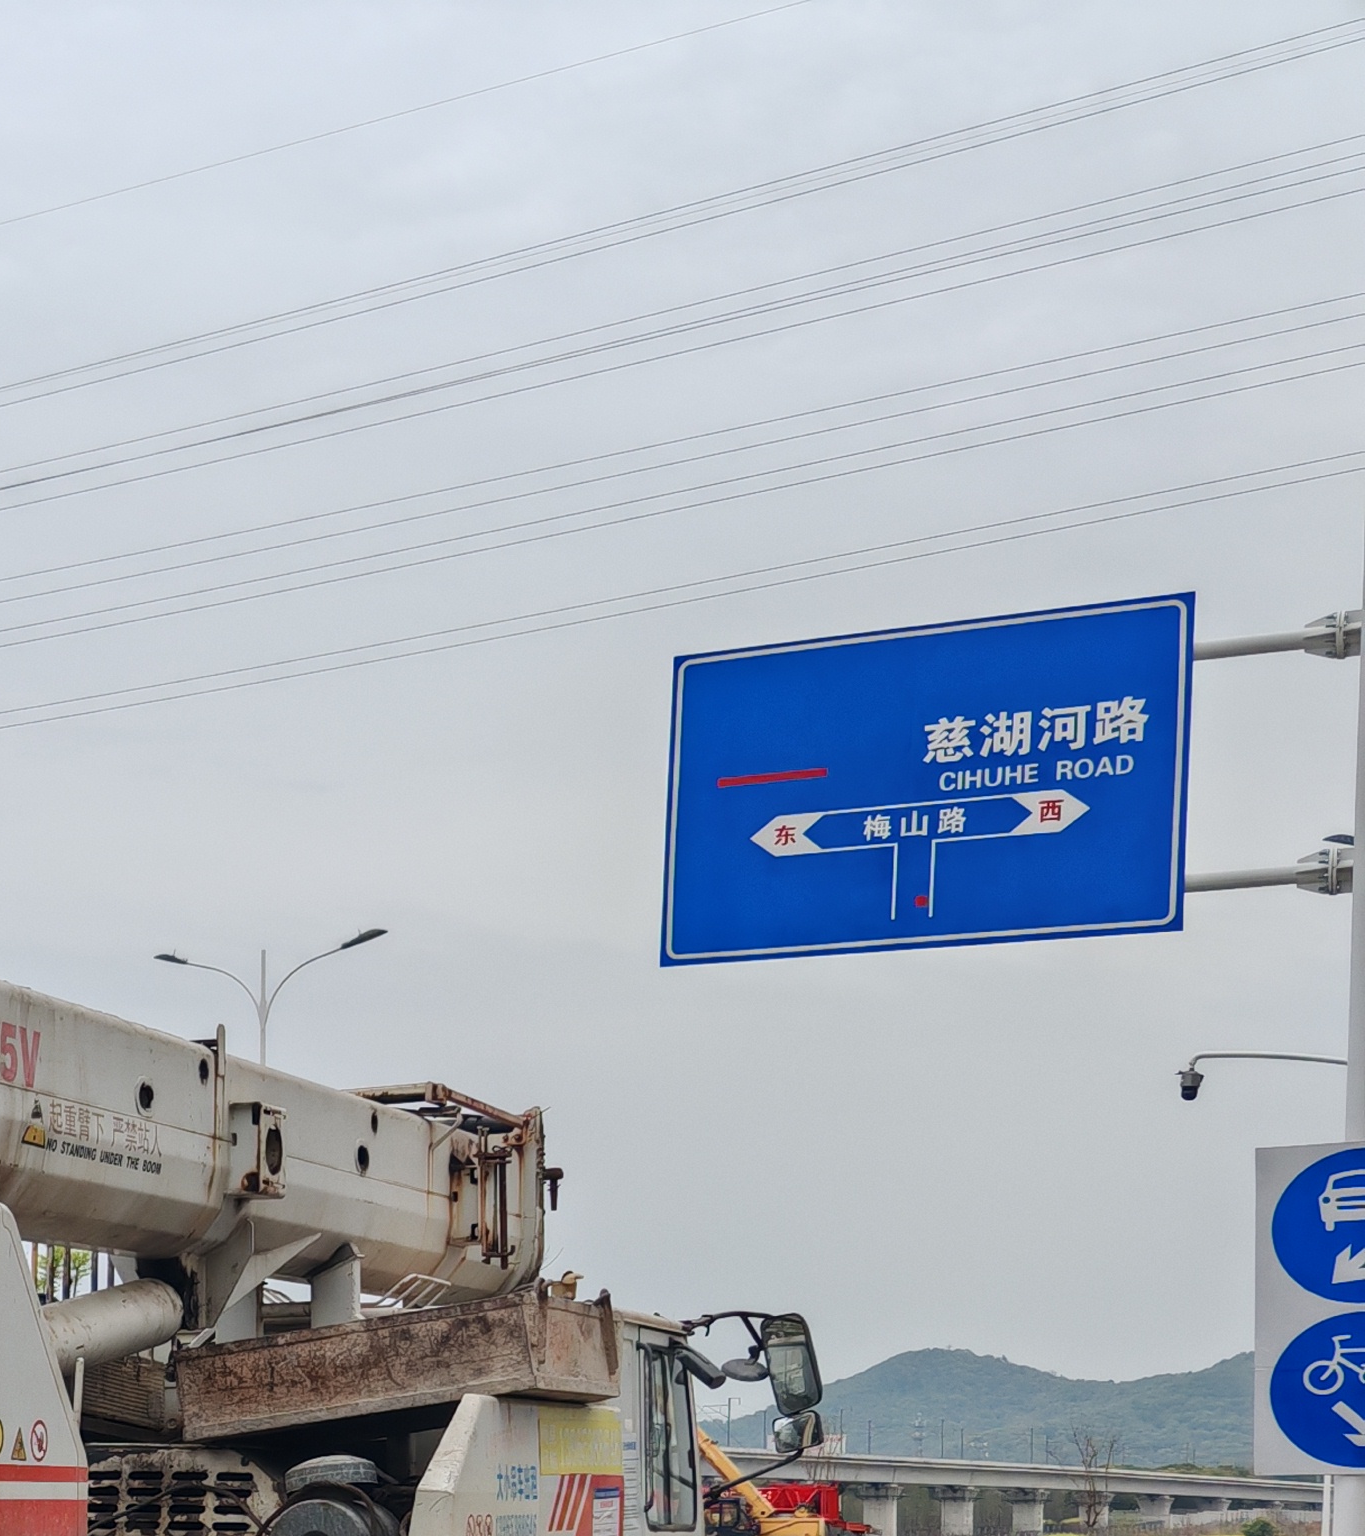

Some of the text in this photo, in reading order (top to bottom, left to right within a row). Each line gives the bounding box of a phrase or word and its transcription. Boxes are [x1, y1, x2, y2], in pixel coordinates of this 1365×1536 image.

[922, 696, 1149, 764] 慈湖河路
[939, 755, 1135, 791] CIHUHE ROAD
[863, 807, 966, 841] 梅山路
[1038, 799, 1063, 822] 西
[774, 825, 797, 846] 东
[46, 1138, 162, 1176] NO STANDING UNDER THE BOOM
